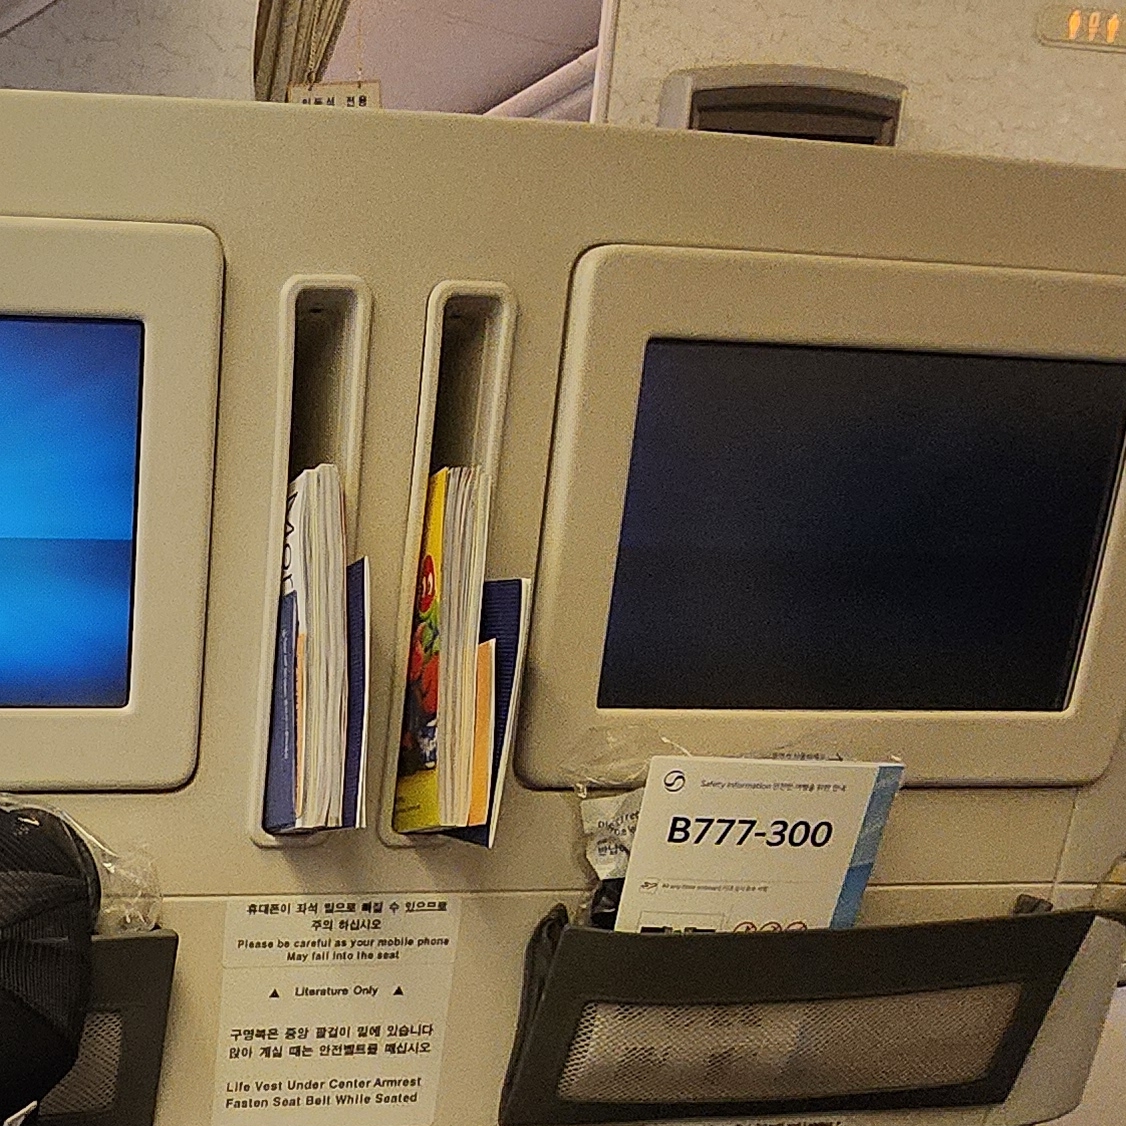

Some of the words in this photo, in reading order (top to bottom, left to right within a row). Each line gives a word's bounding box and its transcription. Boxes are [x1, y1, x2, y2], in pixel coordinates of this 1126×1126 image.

[701, 780, 725, 789] Safety
[667, 816, 833, 848] B777-300
[247, 902, 291, 915] 휴대폰이
[296, 902, 318, 914] 좌석
[324, 902, 356, 913] 밑으로
[389, 901, 400, 913] 수
[405, 901, 447, 913] 있으므로
[311, 919, 333, 931] 주의
[338, 919, 381, 931] 하십시오
[238, 939, 273, 949] Please
[277, 939, 290, 948] be
[294, 938, 330, 948] careful
[335, 939, 347, 947] as
[350, 938, 374, 949] your
[378, 937, 414, 947] mobile
[417, 937, 449, 948] phone
[287, 951, 308, 962] May
[311, 951, 329, 961] fall
[333, 951, 353, 960] into
[357, 950, 374, 959] the
[377, 950, 399, 960] seat
[295, 987, 348, 997] Literature
[353, 986, 378, 997] Only
[231, 1028, 279, 1041] 구명복은
[285, 1027, 309, 1040] 중앙
[316, 1026, 351, 1039] 팔걸이
[357, 1025, 381, 1037] 밑에
[387, 1024, 434, 1037] 있습니다
[229, 1046, 252, 1059] 앉아
[259, 1045, 283, 1058] 계실
[289, 1045, 313, 1057] 때는
[319, 1043, 378, 1056] 안전벨트를
[227, 1082, 250, 1093] Life
[255, 1081, 282, 1092] Vest
[288, 1080, 325, 1090] Under
[329, 1079, 370, 1090] Center
[374, 1077, 421, 1088] Armrest
[226, 1098, 268, 1109] Fasten
[273, 1097, 301, 1107] Seat
[306, 1096, 330, 1106] Belt
[335, 1094, 371, 1105] While
[375, 1092, 417, 1103] Seated
